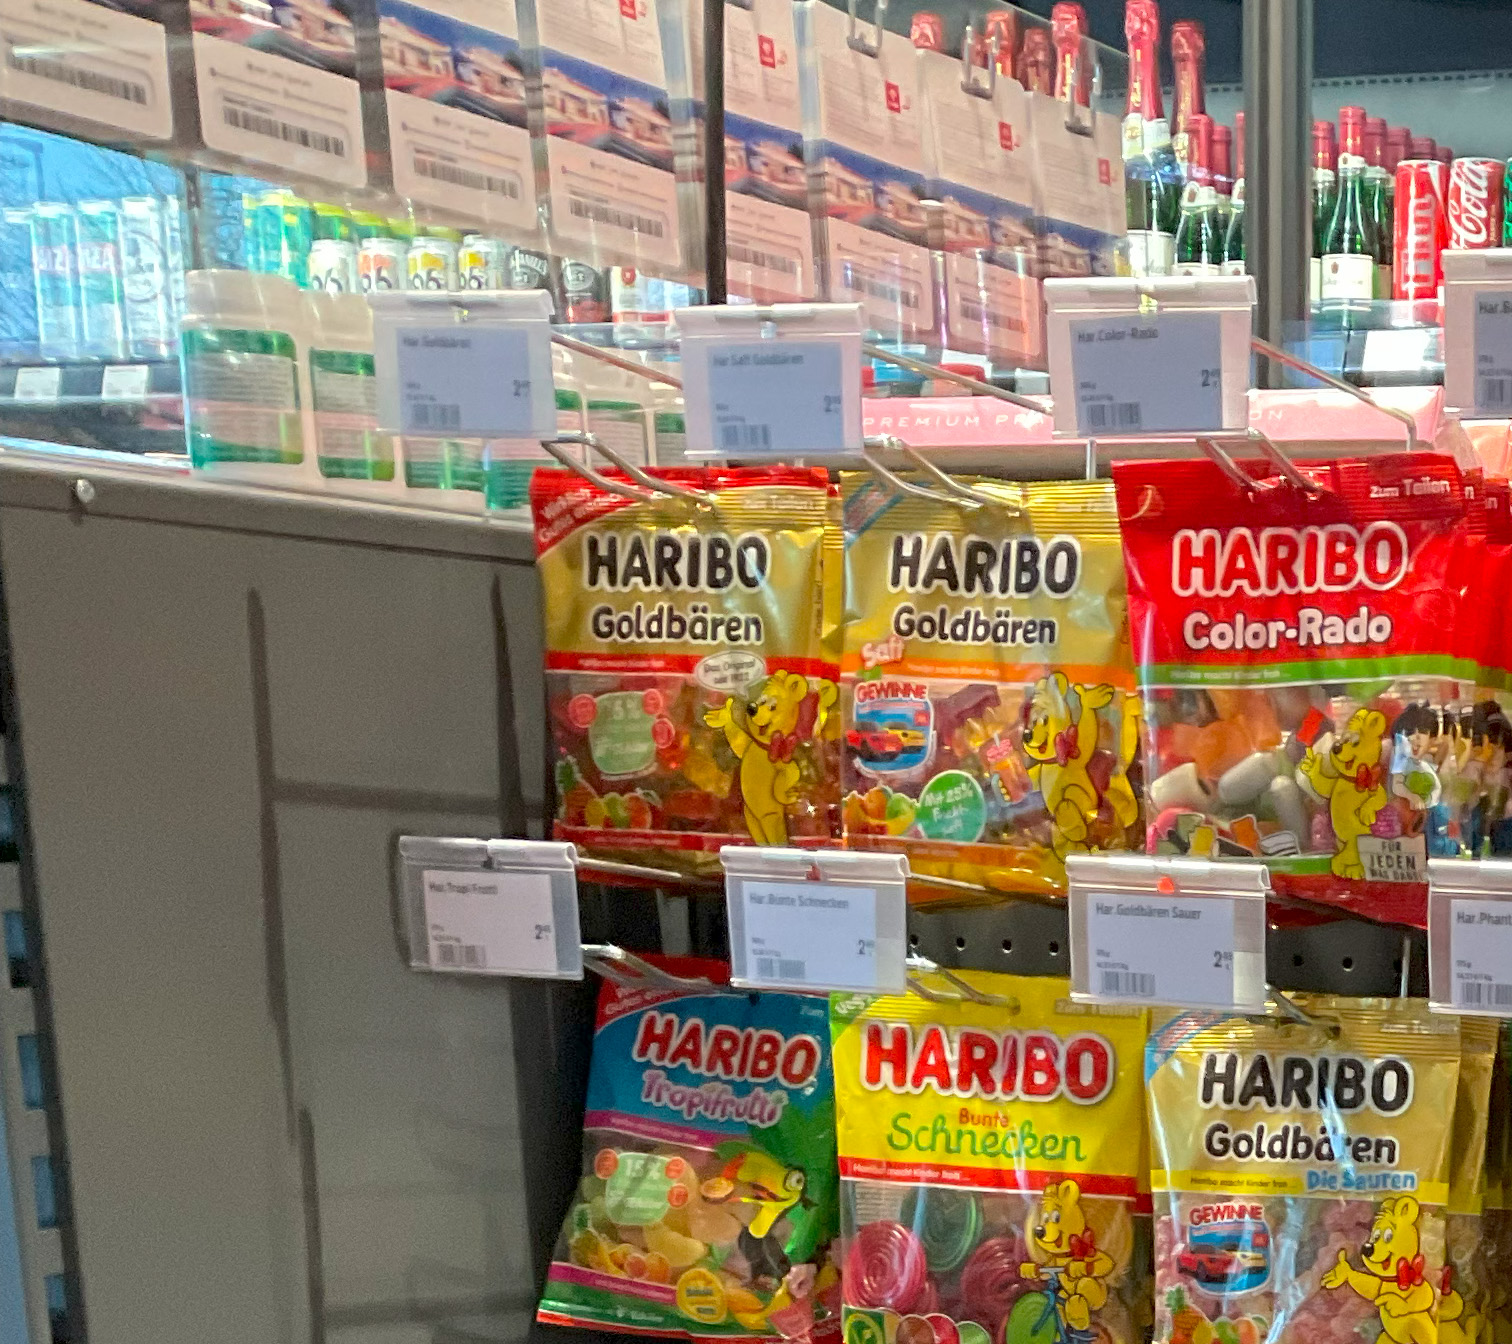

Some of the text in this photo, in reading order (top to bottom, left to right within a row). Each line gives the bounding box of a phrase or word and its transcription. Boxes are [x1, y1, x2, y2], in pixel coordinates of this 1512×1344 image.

[1403, 477, 1451, 494] Teilen
[583, 533, 770, 593] HARIBO
[888, 534, 1081, 597] HARIBO
[1172, 522, 1409, 598] HARIBO
[591, 604, 764, 645] Goldbären
[893, 604, 1057, 645] Goldbären
[1183, 607, 1394, 651] Color-Rado
[855, 682, 928, 702] GEWINNE
[1369, 854, 1417, 870] JEDEN
[1172, 907, 1202, 920] Sauer
[632, 1010, 822, 1092] HARIBO
[861, 1020, 1115, 1105] HARIBO
[1200, 1053, 1415, 1117] HARIBO
[886, 1112, 1086, 1163] Schnecken
[958, 1108, 1010, 1128] Bunte
[1204, 1123, 1399, 1167] Goldbären
[1306, 1169, 1418, 1191] Die Sauren
[1189, 1203, 1265, 1224] GEWINNE
